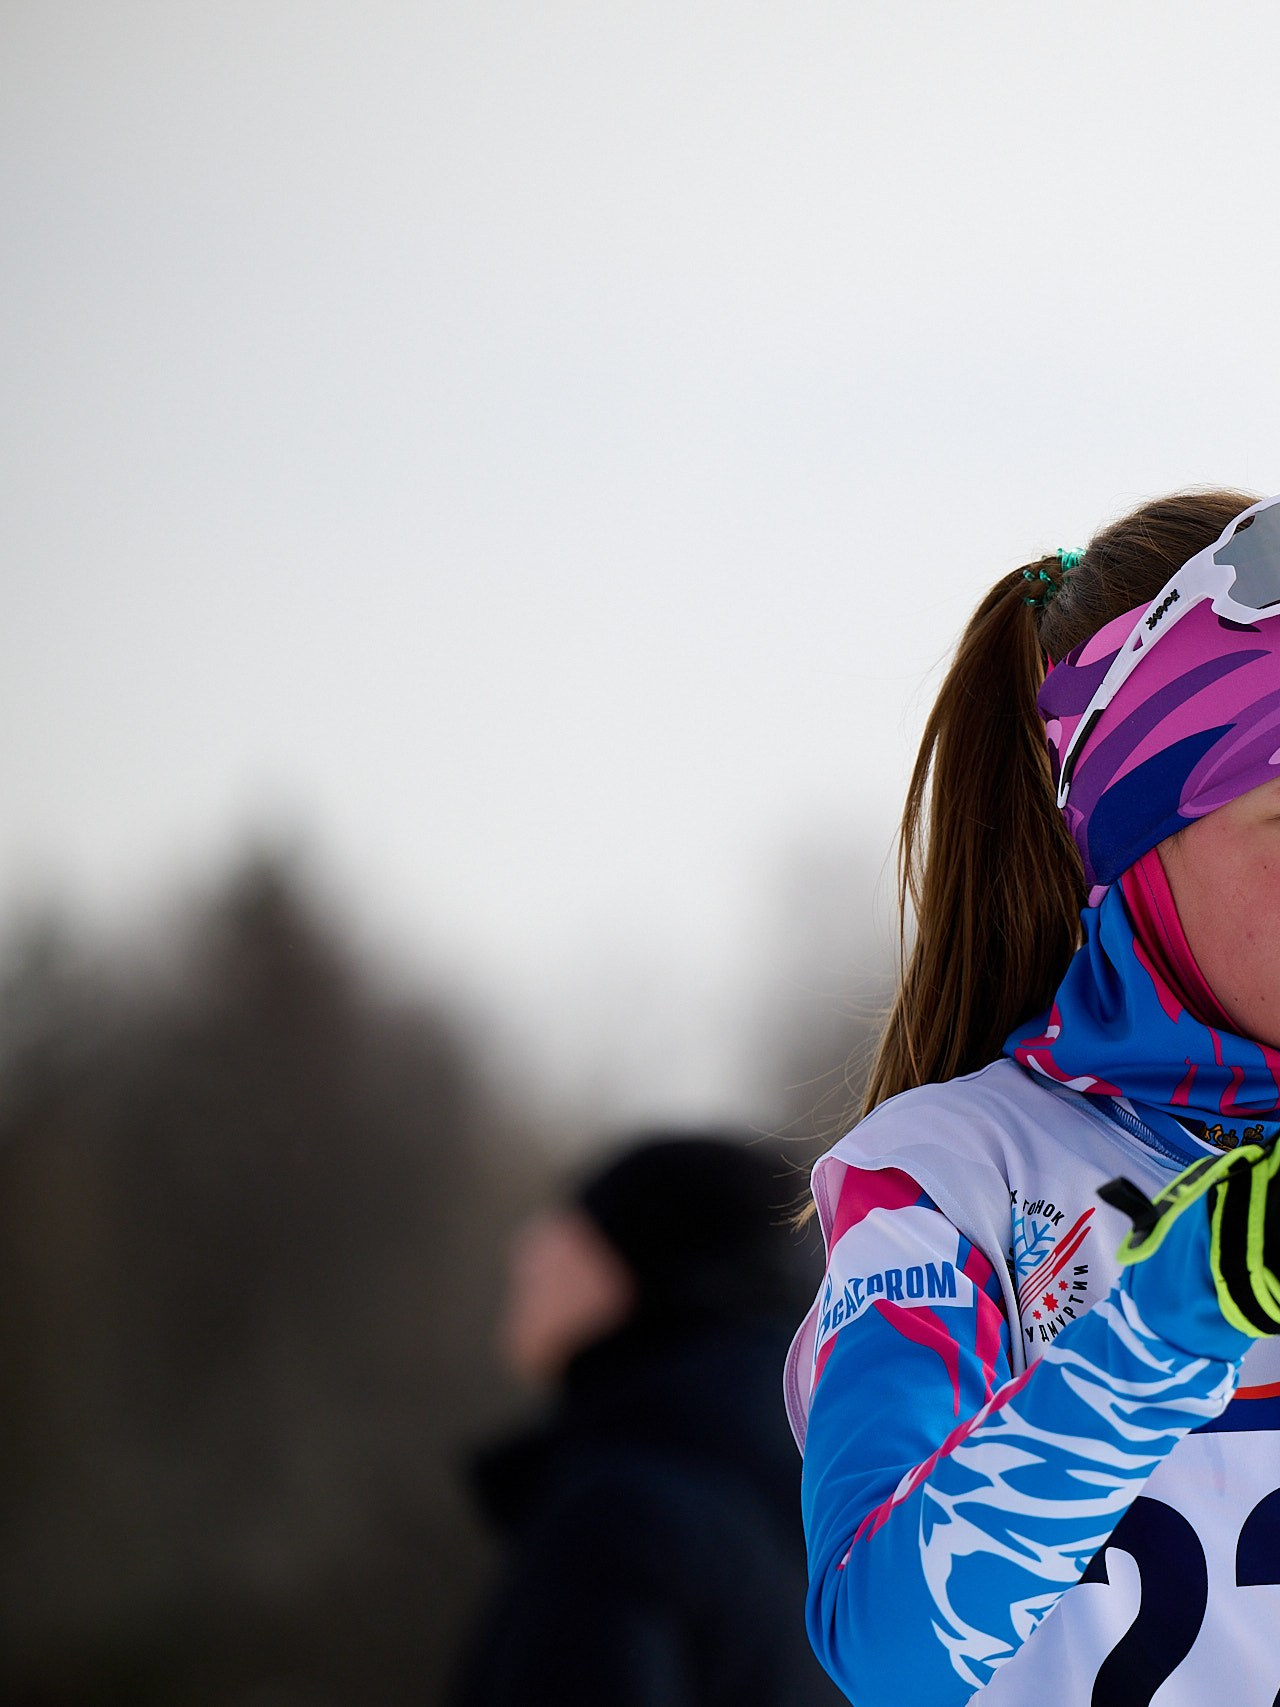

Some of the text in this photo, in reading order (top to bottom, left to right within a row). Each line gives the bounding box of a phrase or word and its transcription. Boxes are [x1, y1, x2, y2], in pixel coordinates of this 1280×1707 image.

[1022, 1199, 1065, 1227] ГОНОК
[832, 1261, 956, 1330] GAZPROM
[1025, 1264, 1089, 1343] УДМУРТИИ
